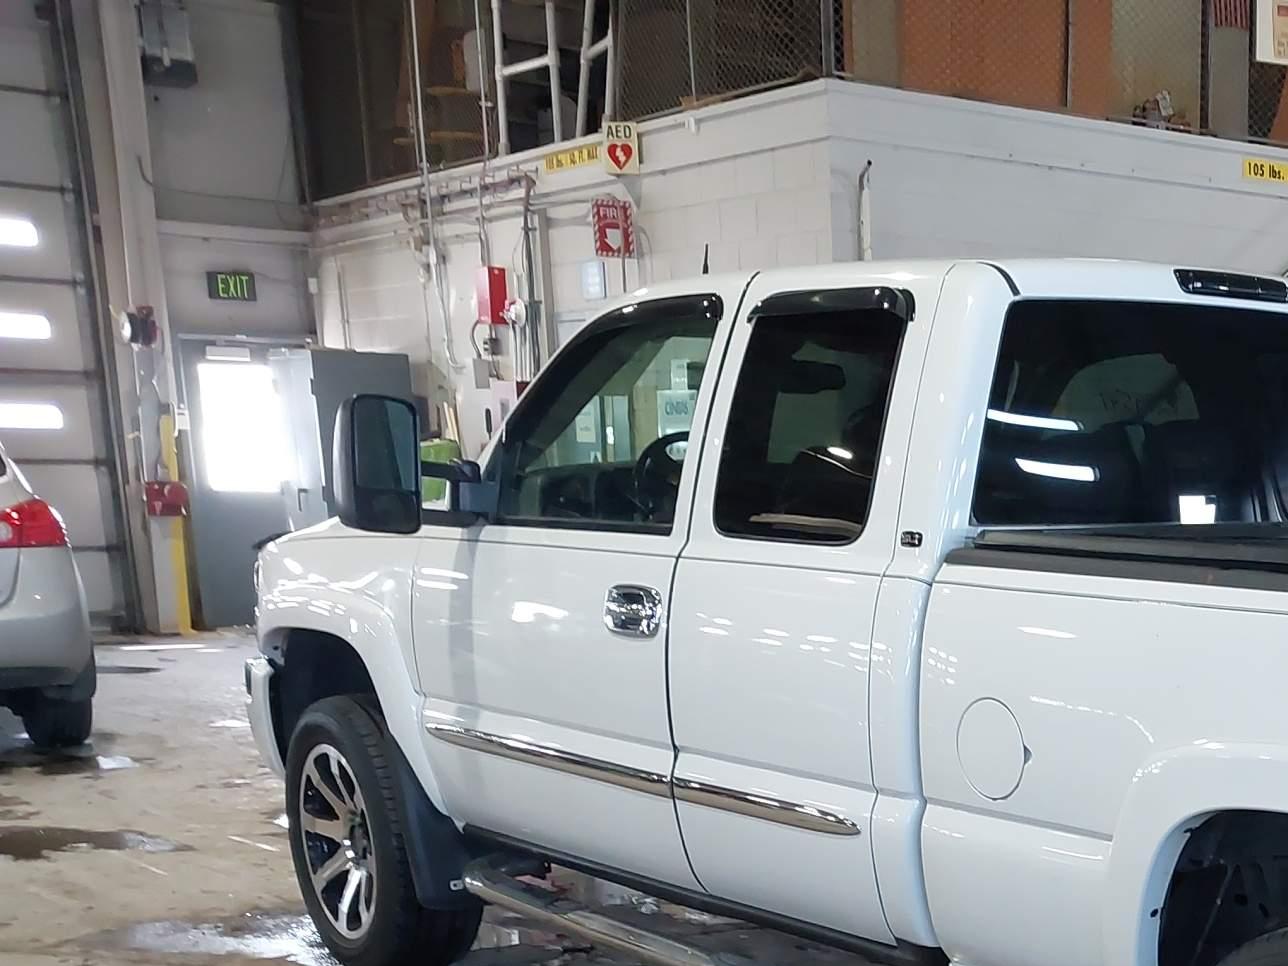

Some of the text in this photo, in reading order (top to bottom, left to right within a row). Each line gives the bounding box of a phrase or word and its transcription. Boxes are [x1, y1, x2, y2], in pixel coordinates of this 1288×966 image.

[606, 124, 632, 139] AED
[1247, 162, 1265, 178] 105
[1268, 164, 1285, 181] lbs.
[600, 206, 624, 219] FIR
[217, 274, 249, 299] EXIT
